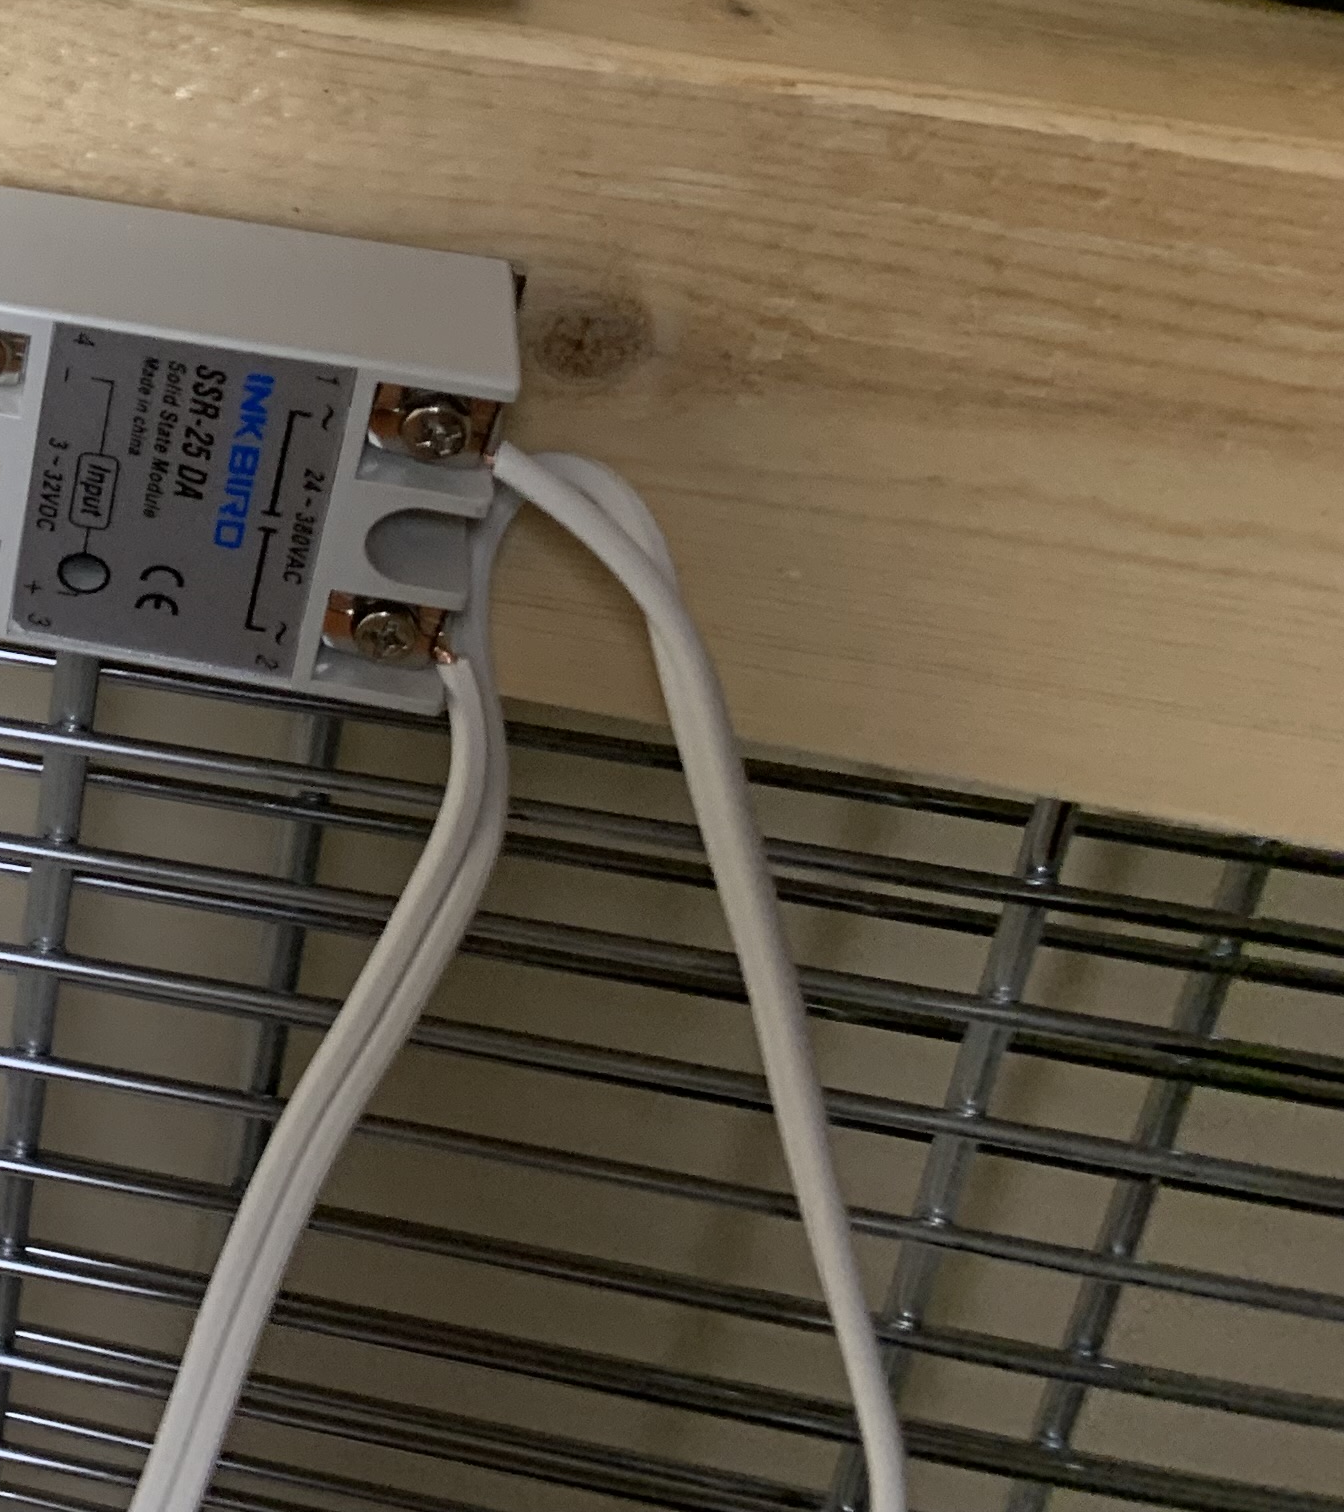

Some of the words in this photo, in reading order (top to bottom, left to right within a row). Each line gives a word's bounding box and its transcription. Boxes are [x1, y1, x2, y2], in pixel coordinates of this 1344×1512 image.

[140, 356, 160, 397] Made
[164, 360, 187, 408] Solid
[135, 400, 148, 414] in
[184, 364, 227, 461] SSR-25
[49, 437, 69, 450] 3
[128, 416, 143, 456] china
[155, 410, 178, 455] State
[174, 460, 208, 500] DA
[214, 372, 277, 550] INKBIRD
[303, 467, 325, 492] 24
[36, 468, 63, 532] 32VDC
[80, 463, 111, 517] Input
[143, 457, 169, 519] Module
[282, 513, 316, 586] 380VAC
[256, 653, 280, 670] 2
